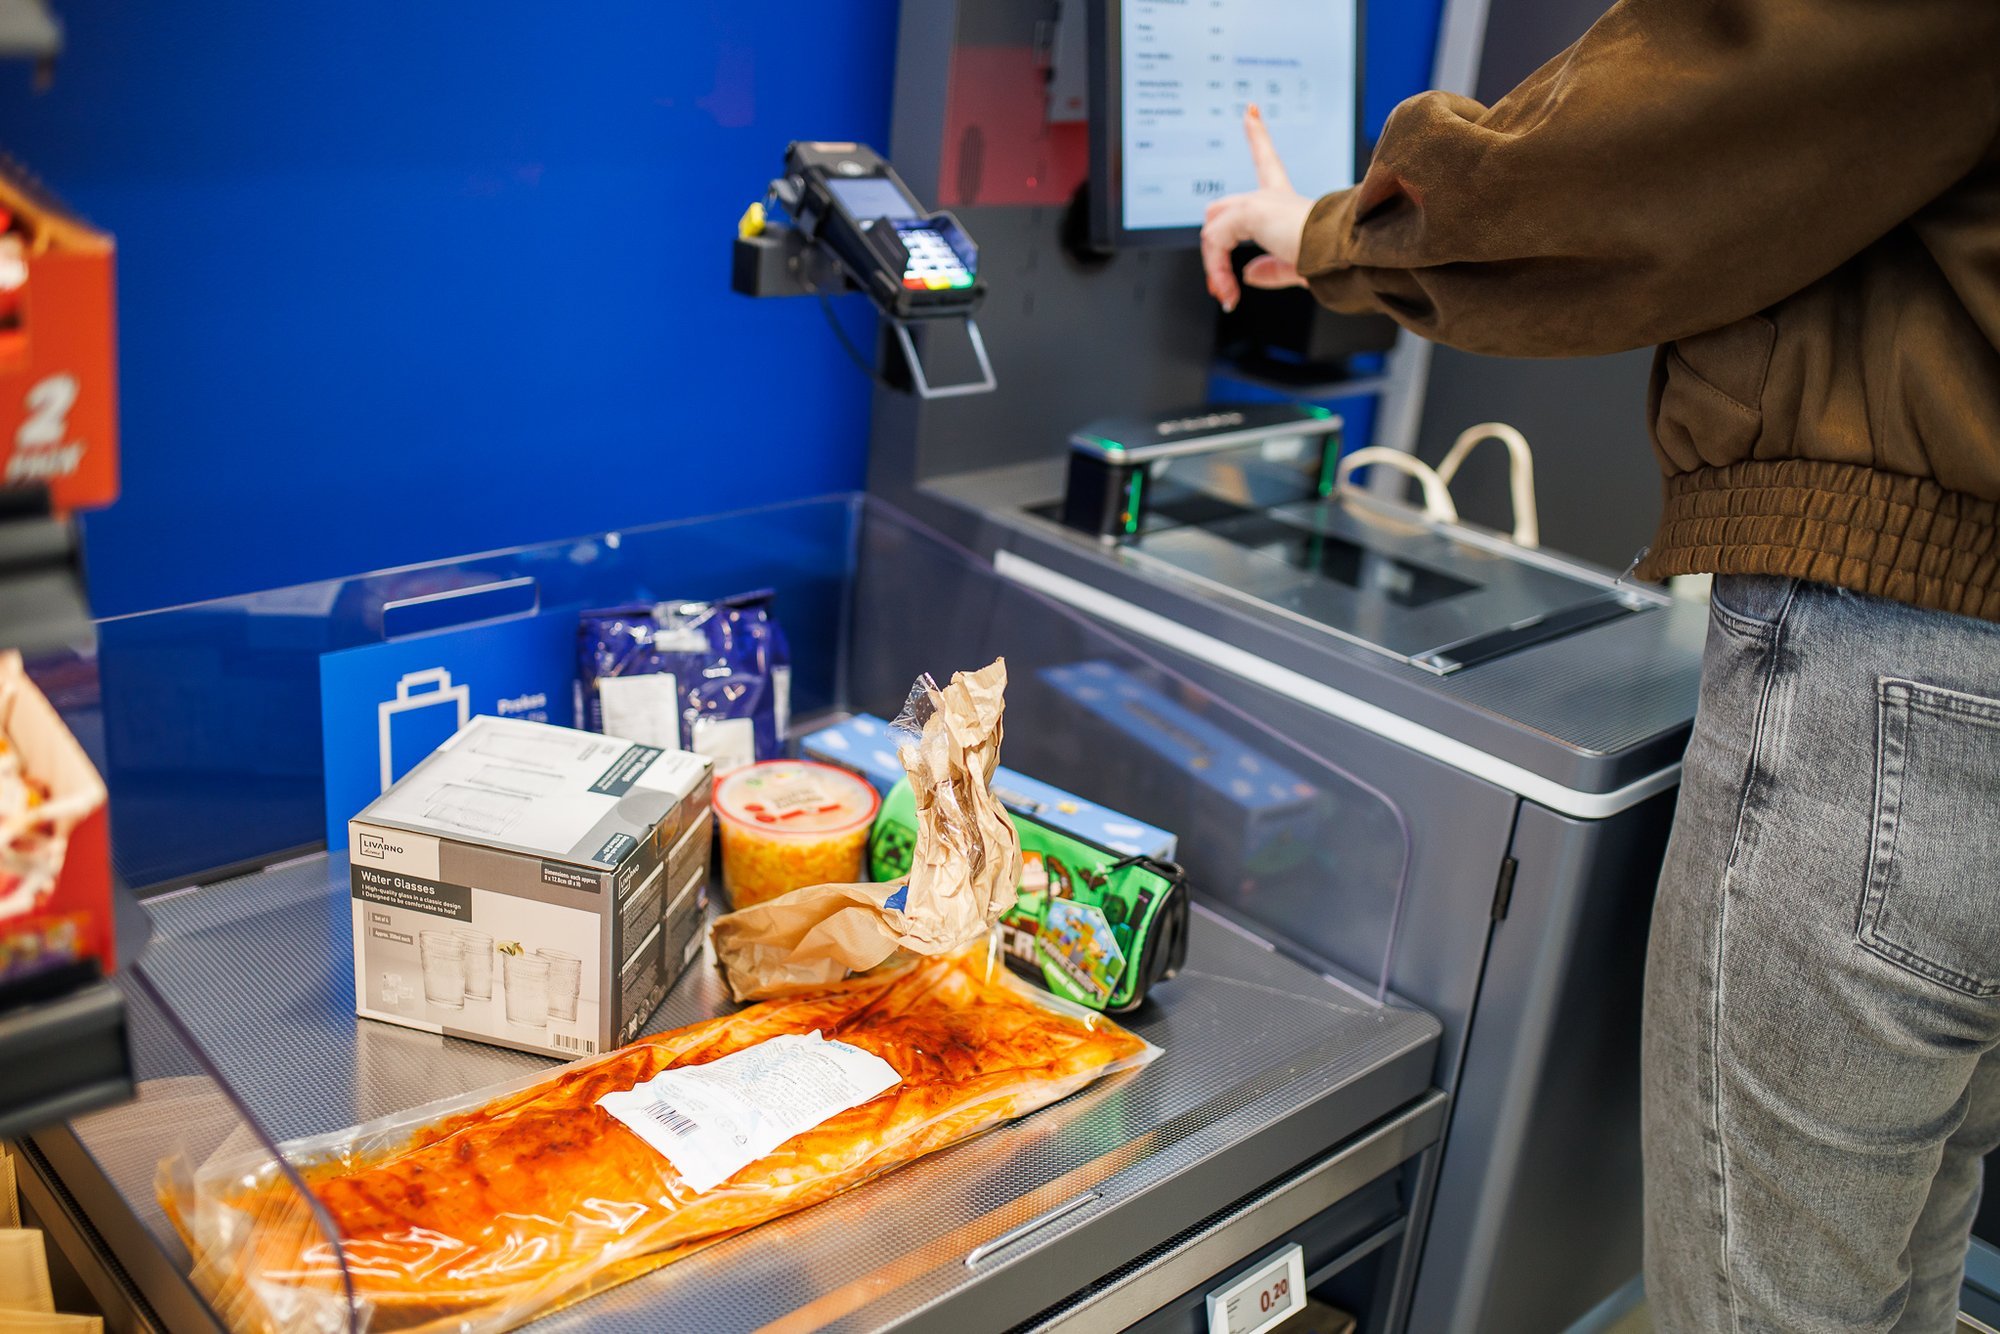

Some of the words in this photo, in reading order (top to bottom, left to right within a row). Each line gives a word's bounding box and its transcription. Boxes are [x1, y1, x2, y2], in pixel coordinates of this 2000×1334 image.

[15, 374, 79, 447] 2
[363, 840, 404, 854] LIVARNO
[361, 870, 392, 886] Water
[394, 877, 435, 895] Glasses
[365, 885, 398, 896] High-quality
[397, 892, 413, 900] glass
[424, 897, 442, 906] classic
[443, 901, 462, 910] design
[365, 890, 390, 902] Designed
[403, 900, 437, 911] comfortable
[443, 907, 456, 916] hold
[1260, 1278, 1288, 1312] 0.20
